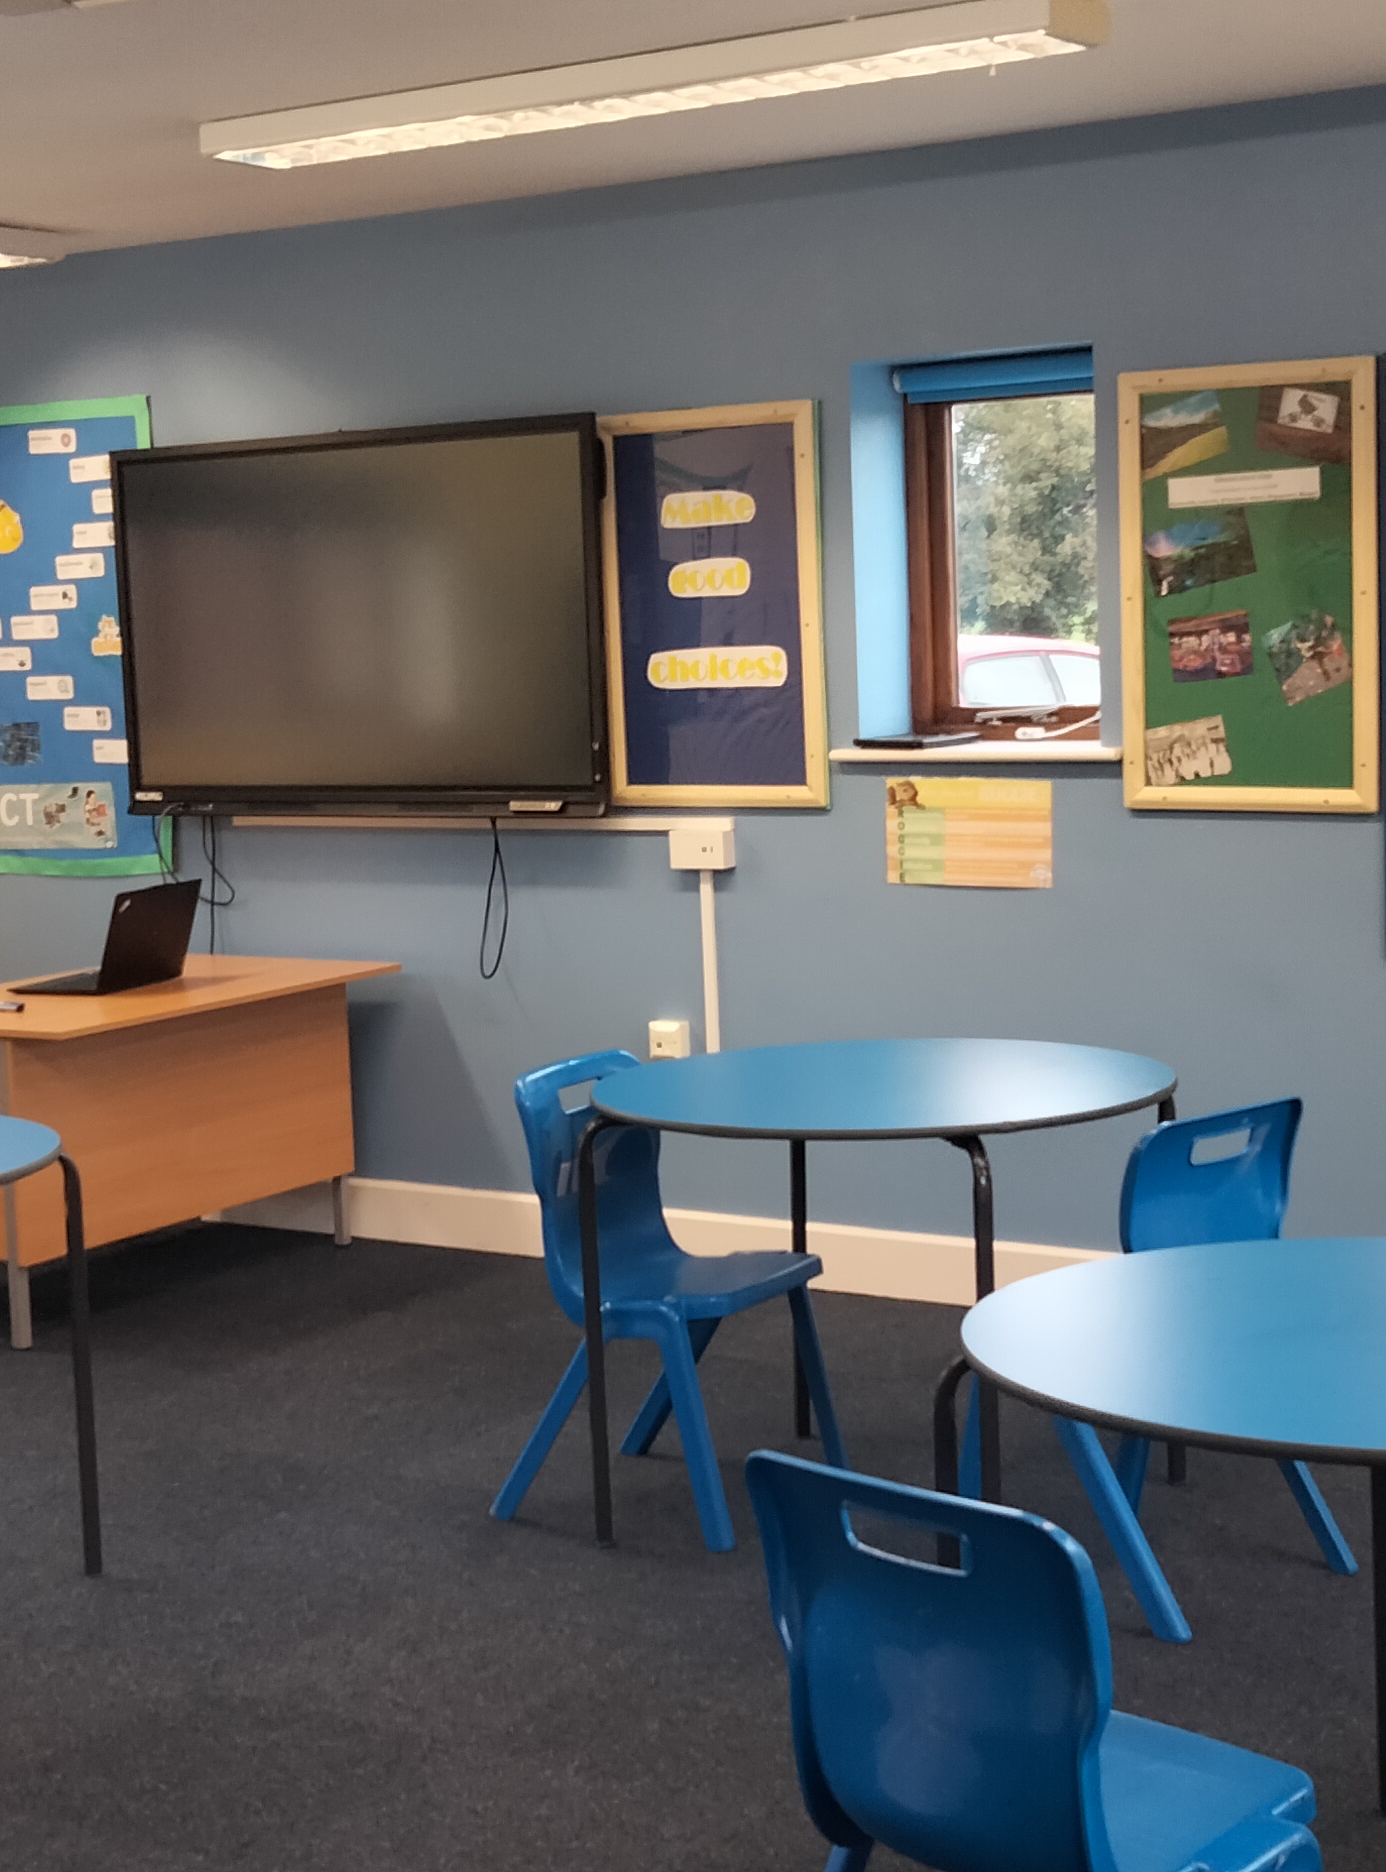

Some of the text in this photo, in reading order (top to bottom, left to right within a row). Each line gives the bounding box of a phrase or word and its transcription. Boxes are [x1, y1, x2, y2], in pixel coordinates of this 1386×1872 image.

[664, 494, 754, 524] Make
[670, 561, 747, 593] good
[650, 651, 782, 683] choices!
